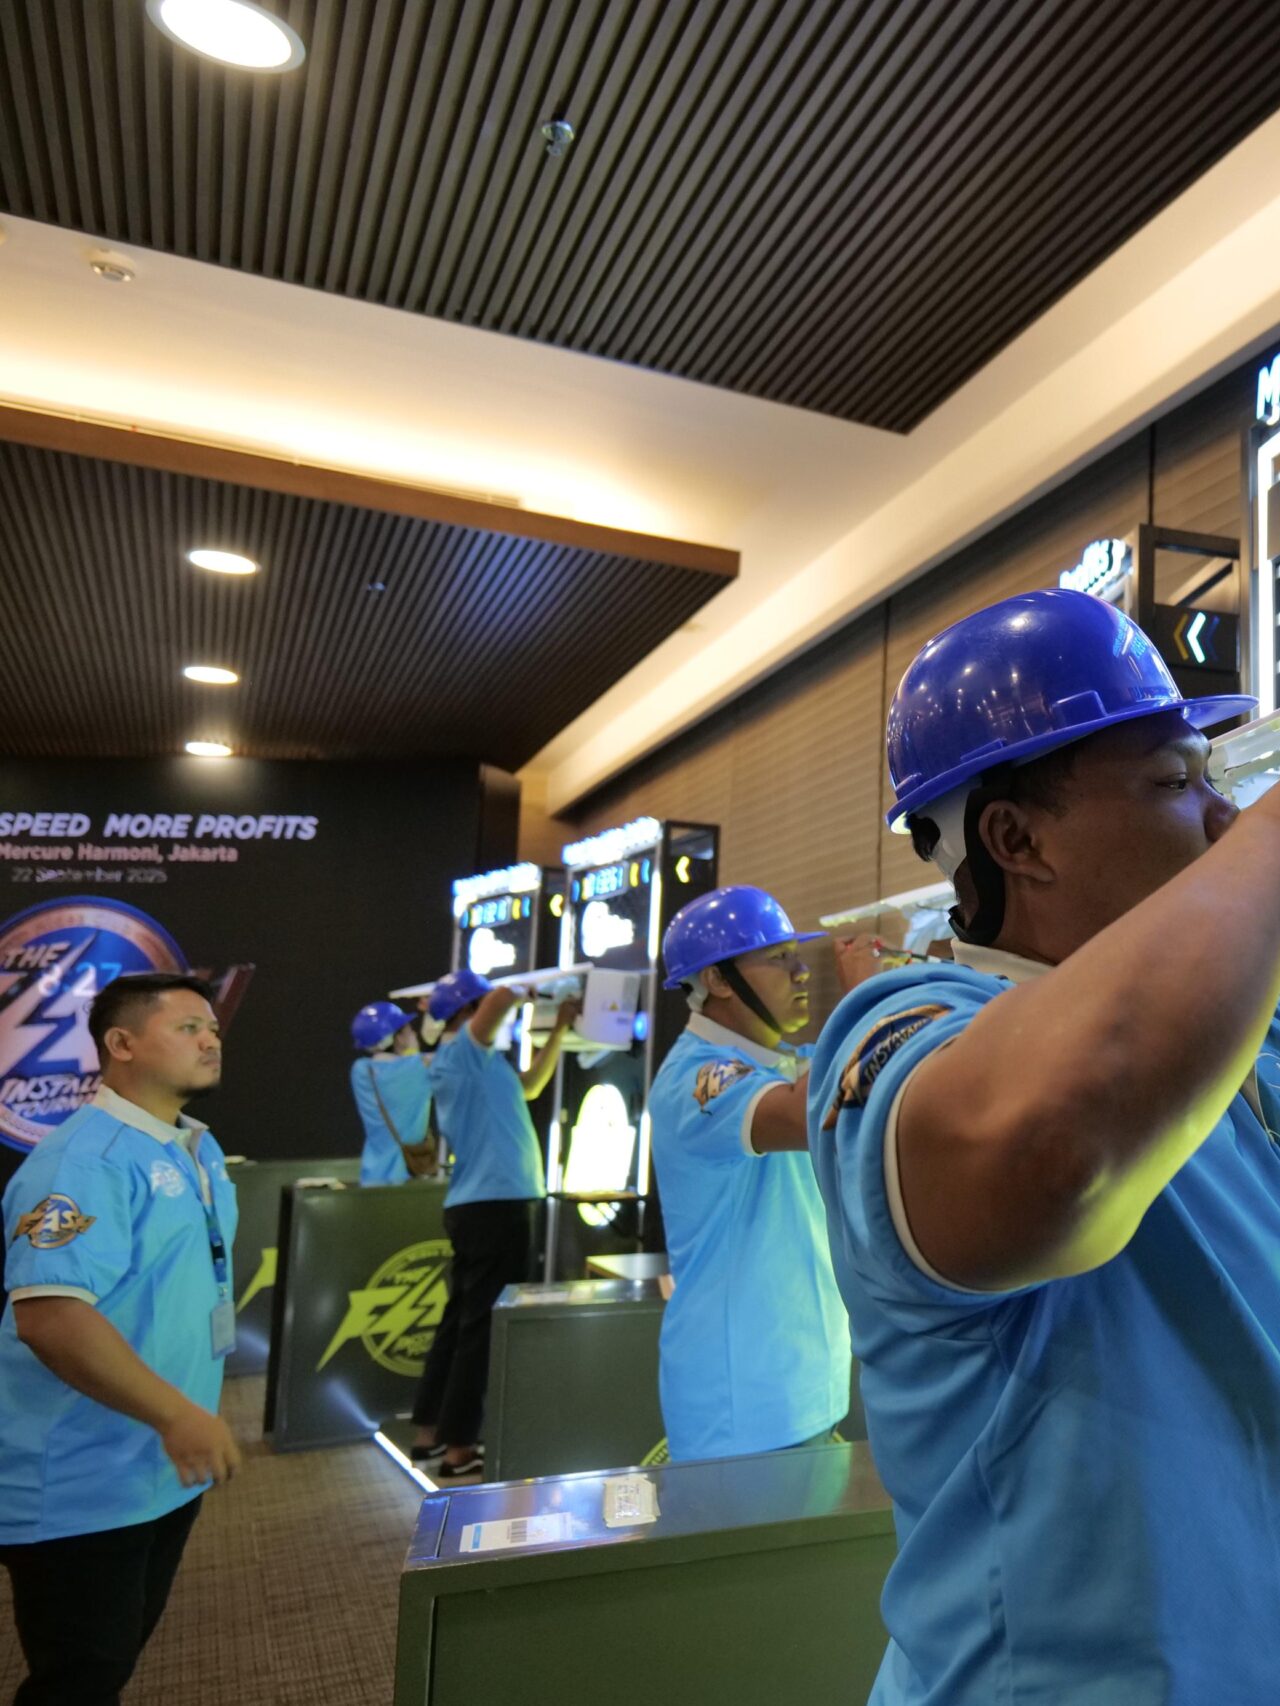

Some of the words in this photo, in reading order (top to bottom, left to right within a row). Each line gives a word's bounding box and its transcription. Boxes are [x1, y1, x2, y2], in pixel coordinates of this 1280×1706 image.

[0, 812, 91, 837] SPEED
[103, 813, 193, 839] MORE
[194, 814, 319, 841] PROFITS
[77, 843, 164, 863] Harmoni,
[167, 844, 239, 862] Jakarta
[4, 941, 72, 968] THE
